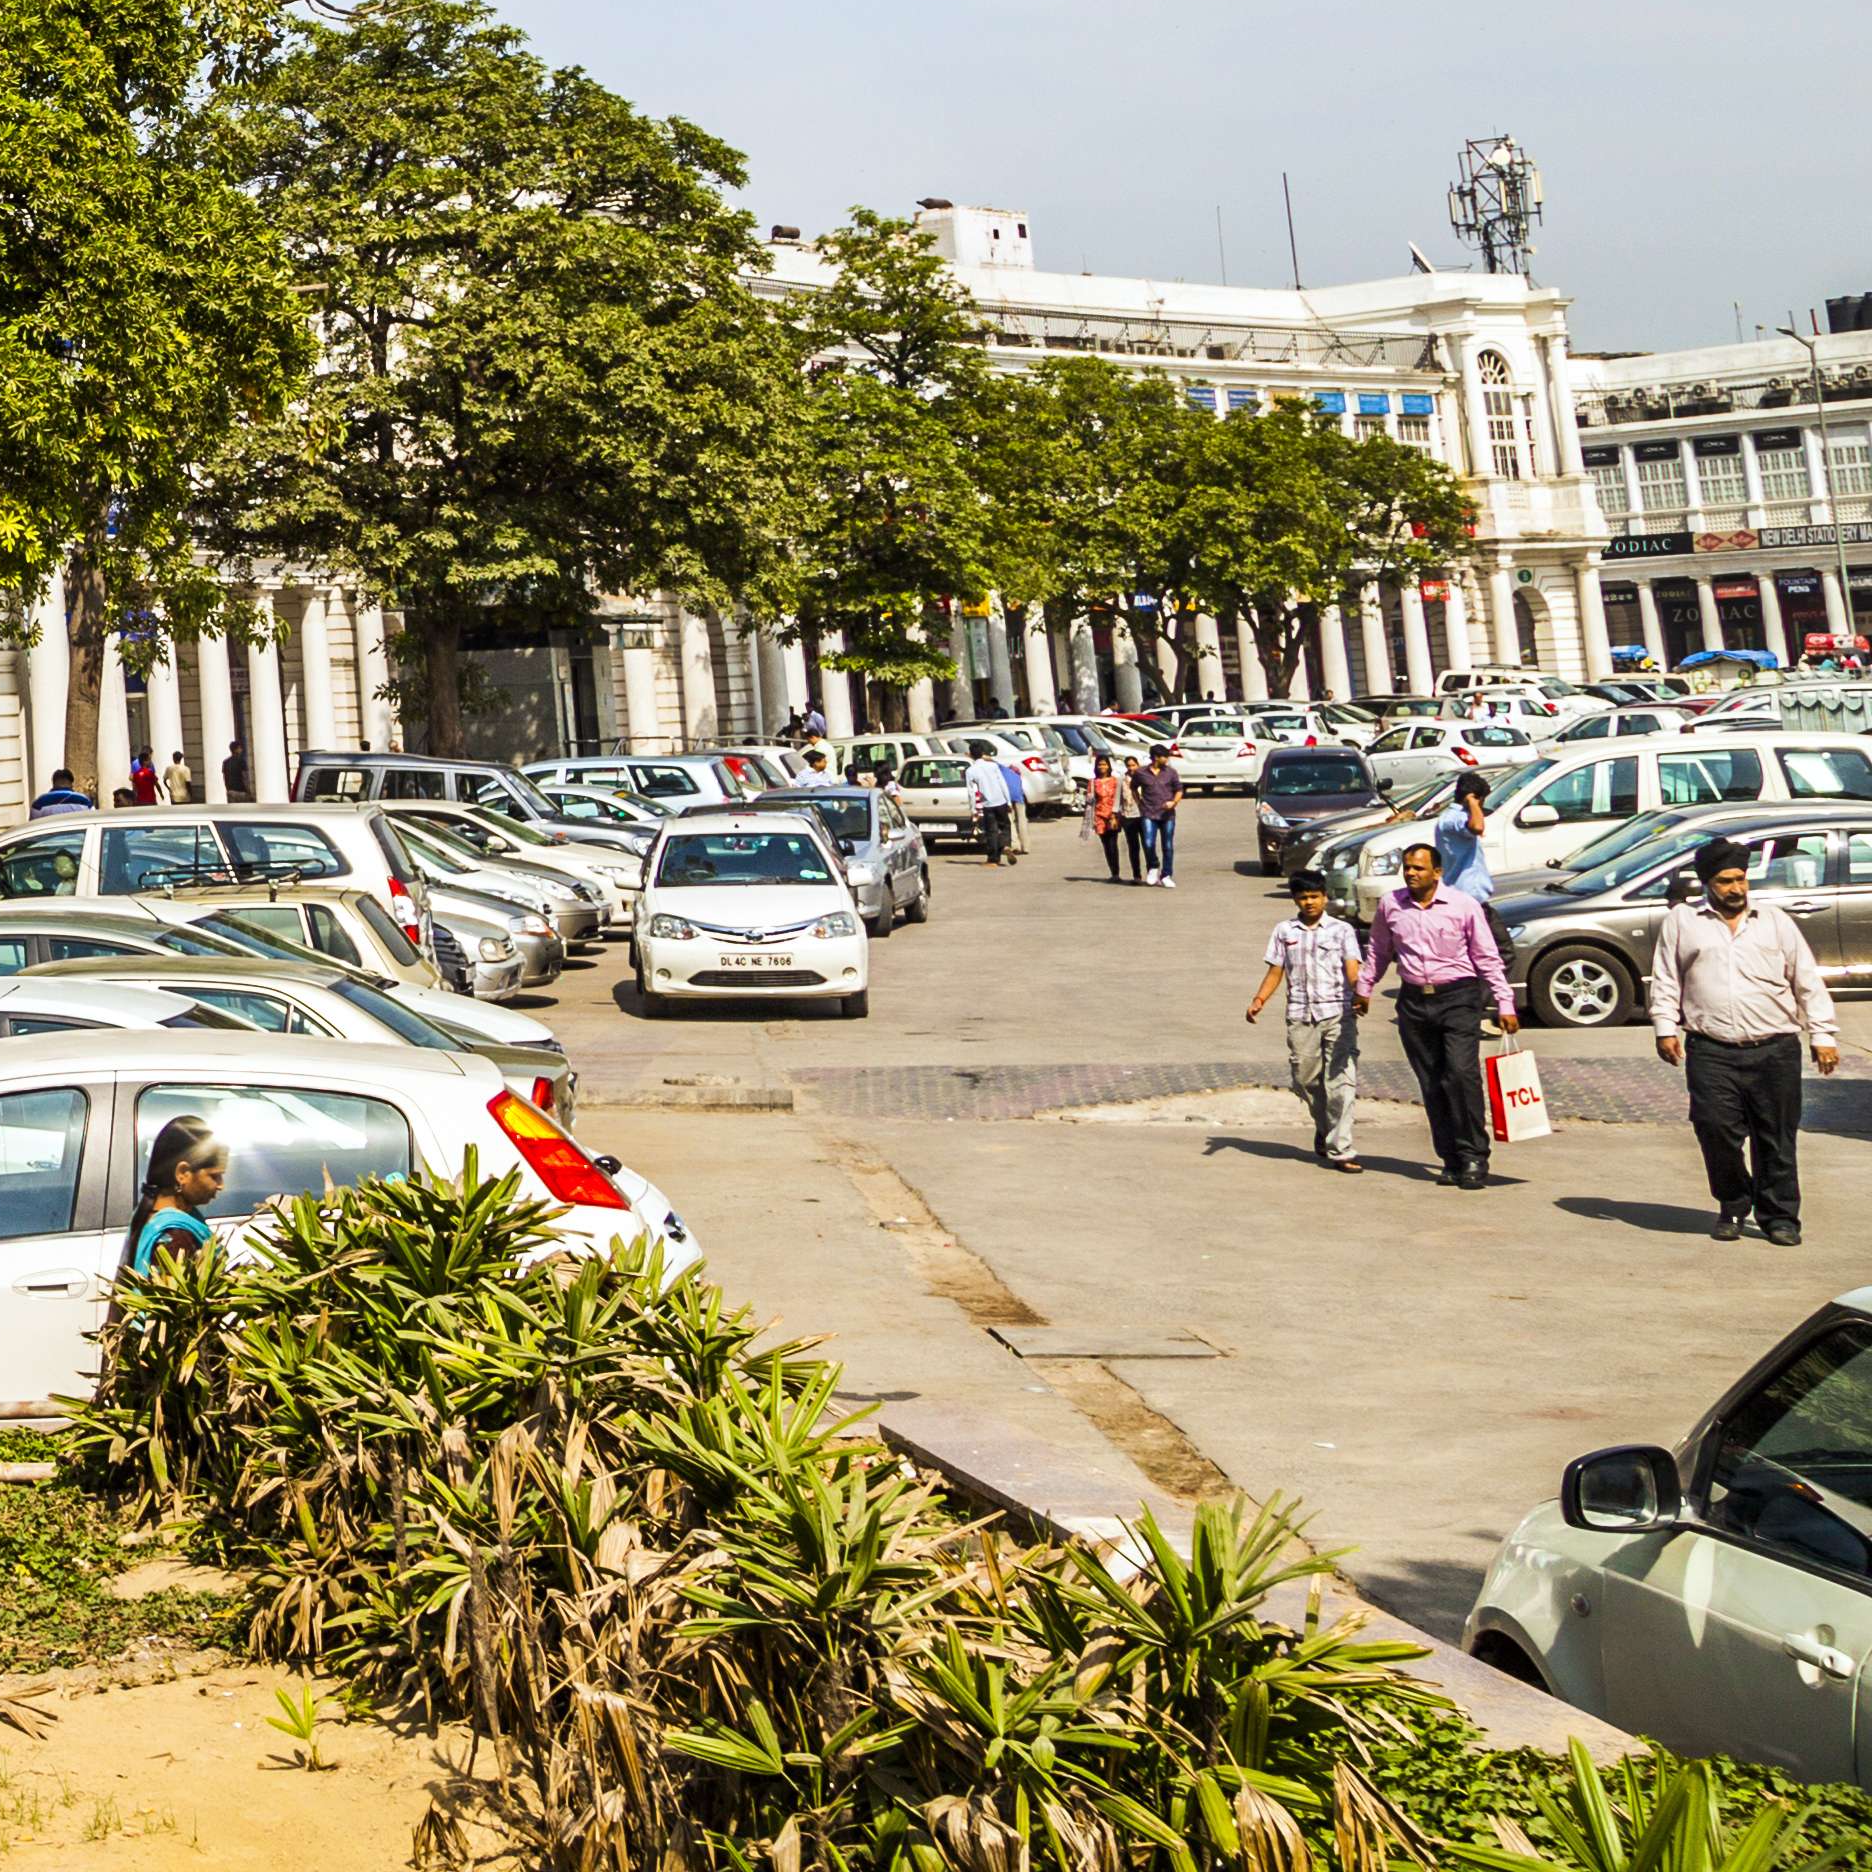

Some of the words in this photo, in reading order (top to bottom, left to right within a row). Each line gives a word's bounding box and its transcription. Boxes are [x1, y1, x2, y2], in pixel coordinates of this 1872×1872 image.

[1761, 529, 1780, 546] NEW
[1781, 527, 1807, 545] DELHI
[1807, 524, 1858, 543] STATIOERY
[1603, 538, 1672, 555] ZODIAC
[720, 957, 732, 966] DL
[735, 957, 747, 966] 4C
[751, 957, 762, 966] NE
[1506, 1086, 1541, 1108] TCL
